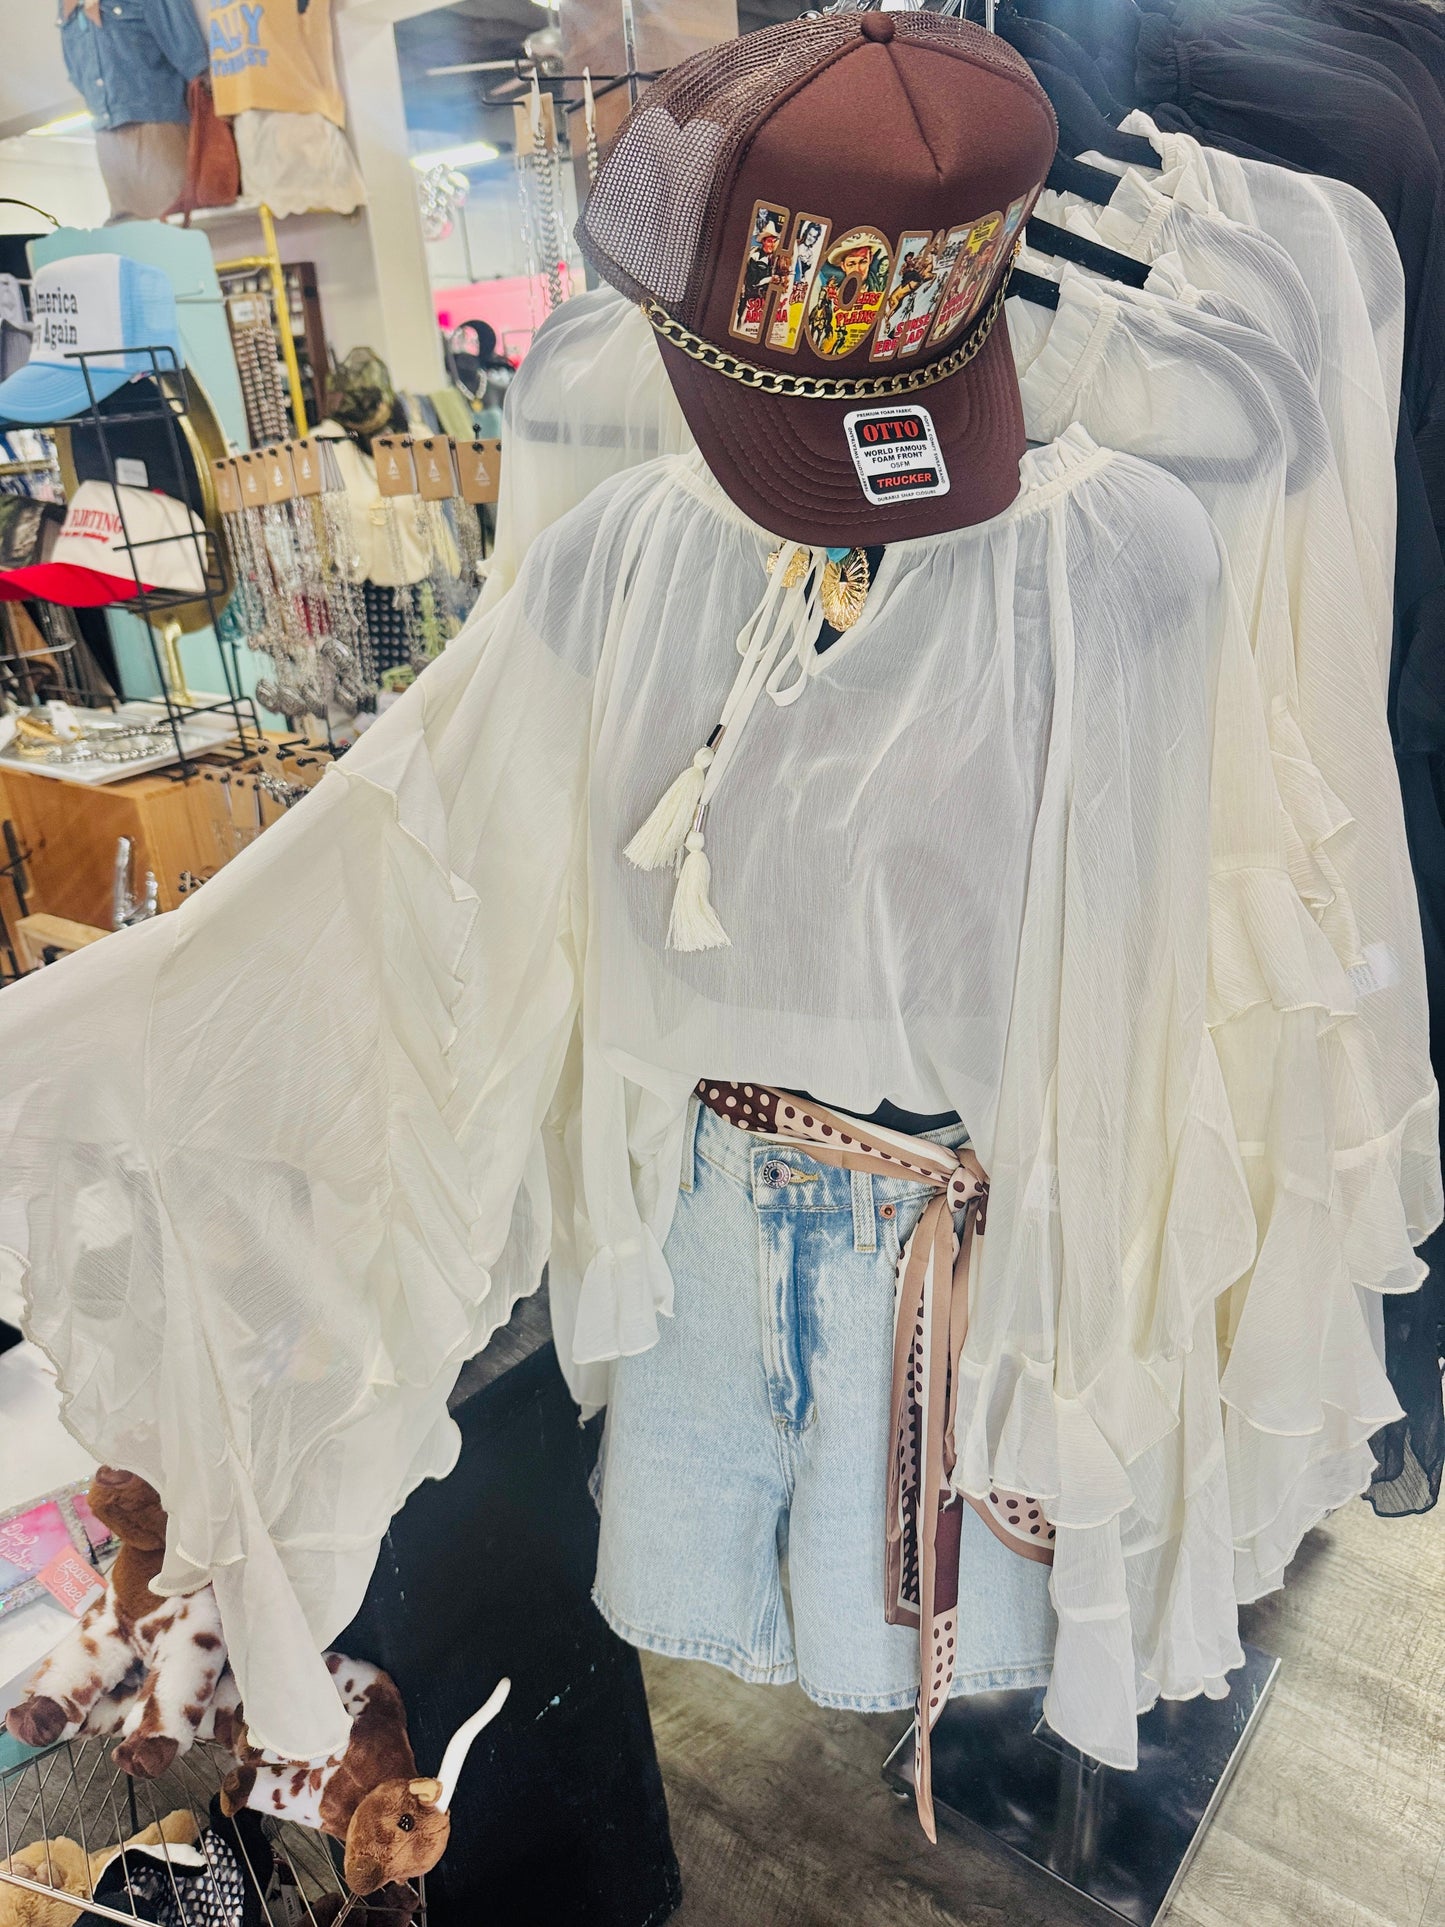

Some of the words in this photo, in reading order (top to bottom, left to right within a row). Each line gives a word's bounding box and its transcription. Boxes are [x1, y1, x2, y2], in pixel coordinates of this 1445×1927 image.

[863, 420, 919, 442] OTTO
[848, 427, 860, 460] SWEATBAND
[864, 447, 894, 458] WORLD
[895, 444, 928, 454] FAMOUS
[872, 454, 896, 464] FOAM
[897, 451, 923, 461] FRONT
[890, 461, 911, 469] OSFM
[877, 472, 932, 489] TRUCKER
